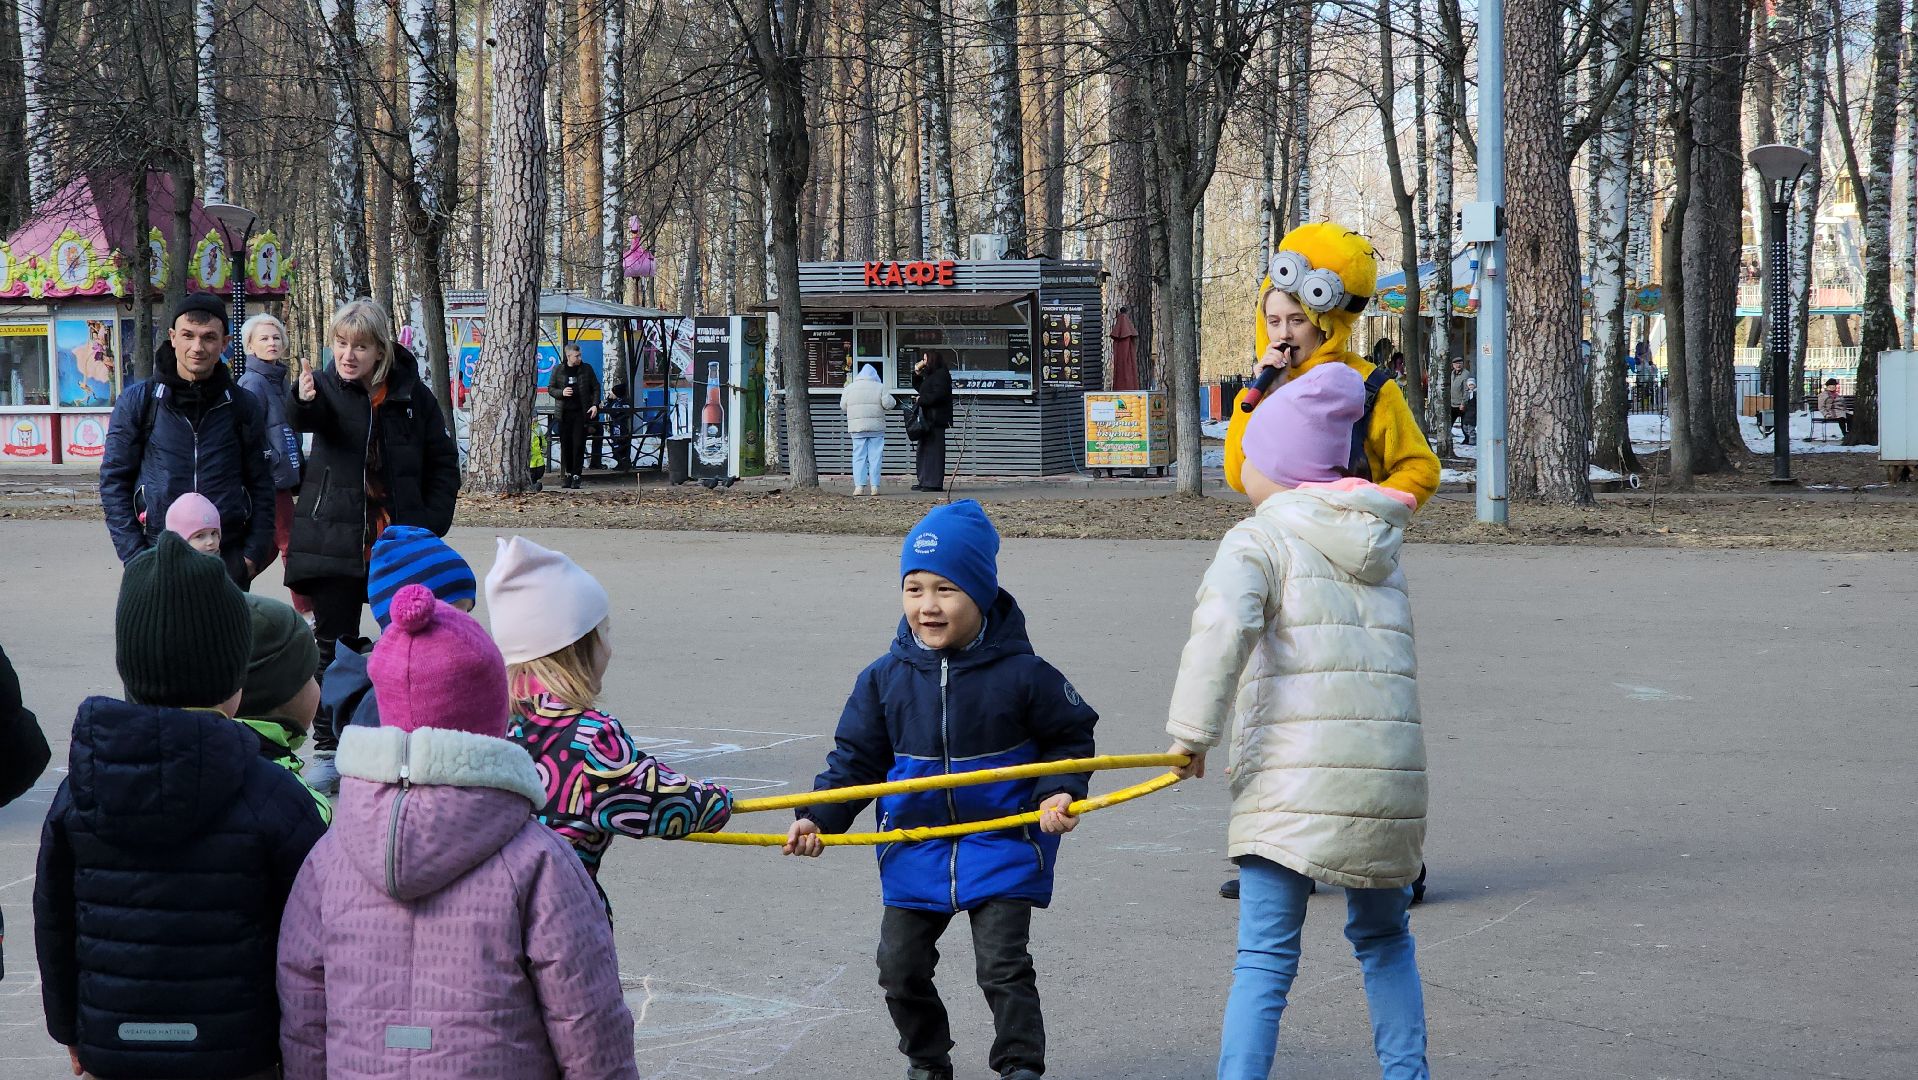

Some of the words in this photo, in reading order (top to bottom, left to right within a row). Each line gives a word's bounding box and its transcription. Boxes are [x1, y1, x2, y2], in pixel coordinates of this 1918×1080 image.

[864, 260, 955, 286] КАФЕ
[966, 381, 980, 389] ХОТ
[981, 381, 997, 389] ДОГ
